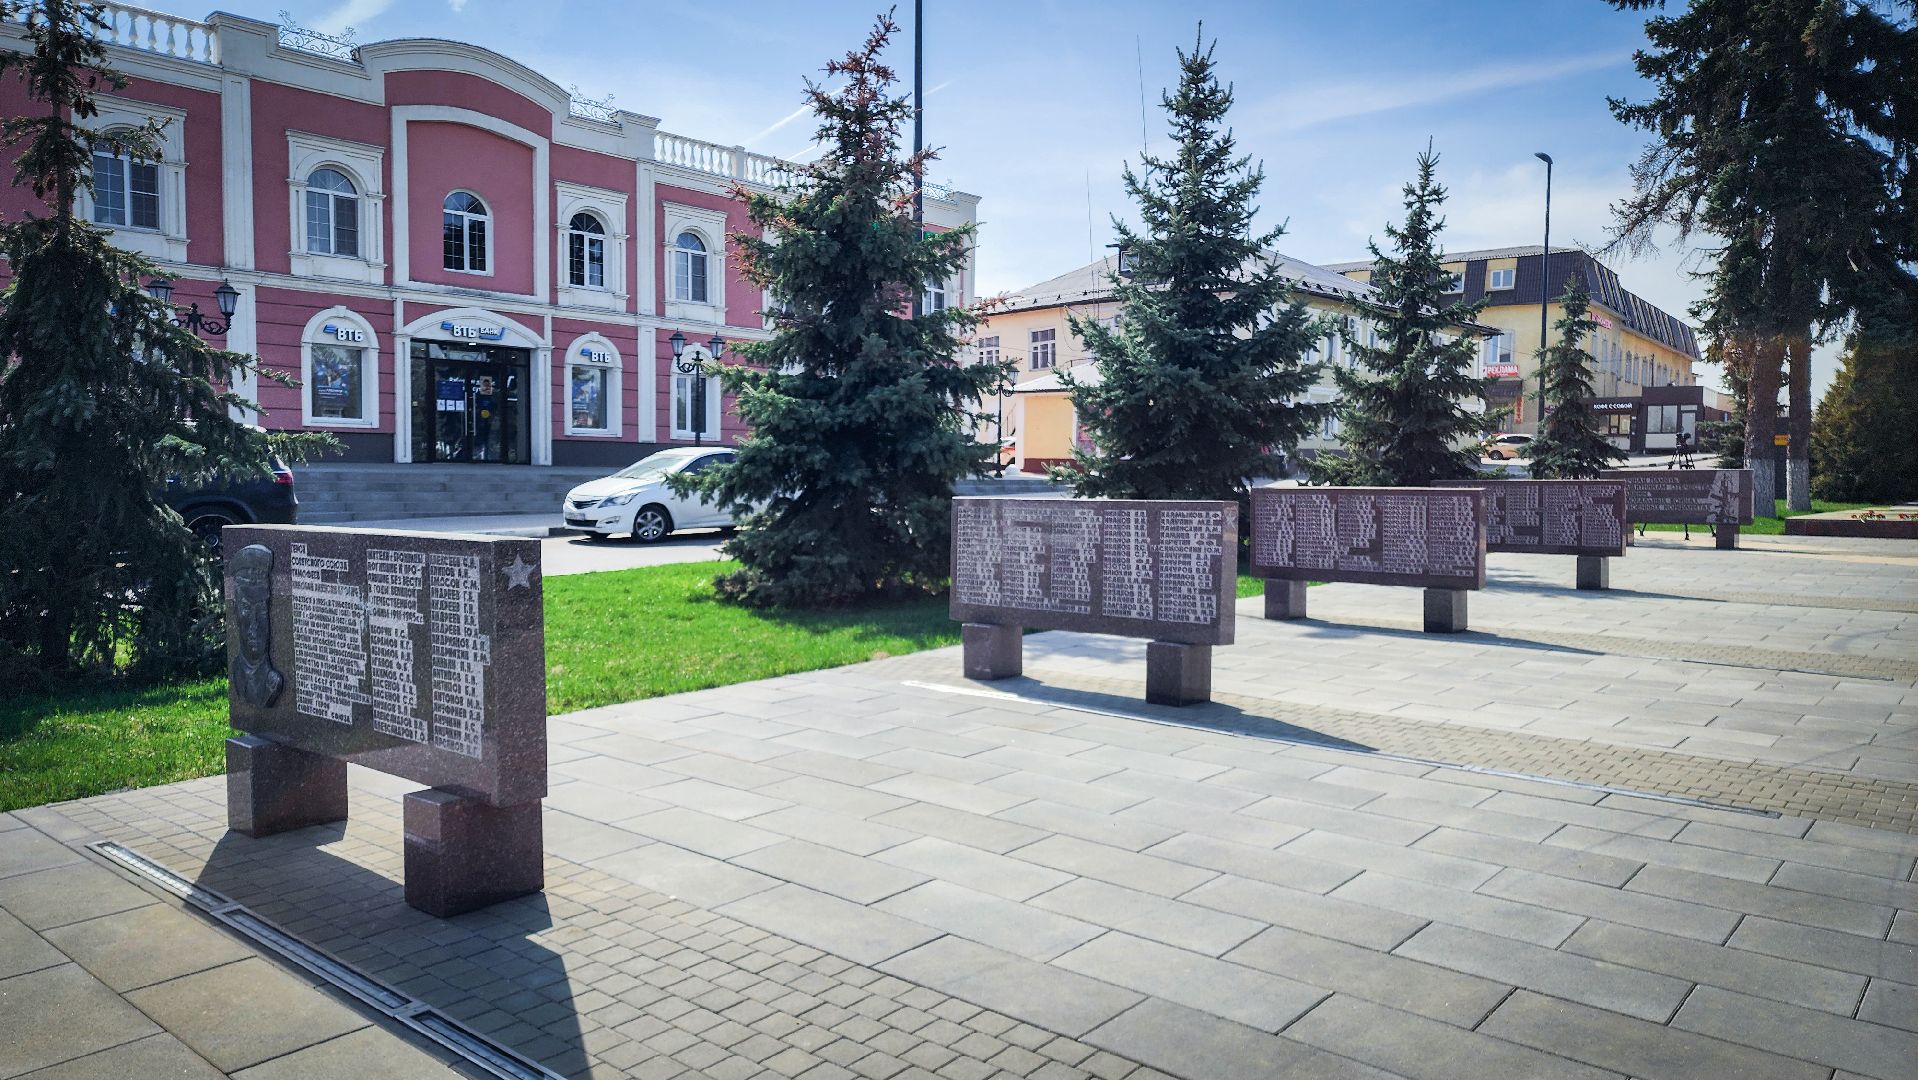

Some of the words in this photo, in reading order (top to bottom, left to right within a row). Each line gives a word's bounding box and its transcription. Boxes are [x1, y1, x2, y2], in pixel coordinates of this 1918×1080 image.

[337, 327, 364, 342] ВТБ
[453, 325, 478, 338] ВТБ
[480, 327, 499, 336] БАНК
[591, 351, 612, 364] ВТБ
[1487, 366, 1518, 374] РЕКЛАМА
[292, 557, 324, 568] СОВЕТСКОГО
[326, 560, 348, 570] СОЮЗА
[390, 574, 402, 585] БЕЗ
[403, 576, 422, 588] ВЕСТИ
[430, 576, 460, 588] АМОСОВ
[463, 579, 480, 591] С.М.
[431, 587, 460, 601] АНДРЕЕВ
[432, 599, 460, 612] АНДРЕЕВ
[1158, 606, 1198, 614] КИРСАНОВ
[1159, 600, 1197, 608] КИРСАНОВ
[432, 610, 460, 624] АНДРЕЕВ
[432, 622, 461, 636] АНДРЕЕВ
[434, 690, 464, 706] АНТОНОВ
[331, 711, 350, 722] СОЮЗА
[374, 709, 412, 728] АЛЕКСАНДРОВ
[374, 720, 413, 740] АЛЕКСАНДРОВ
